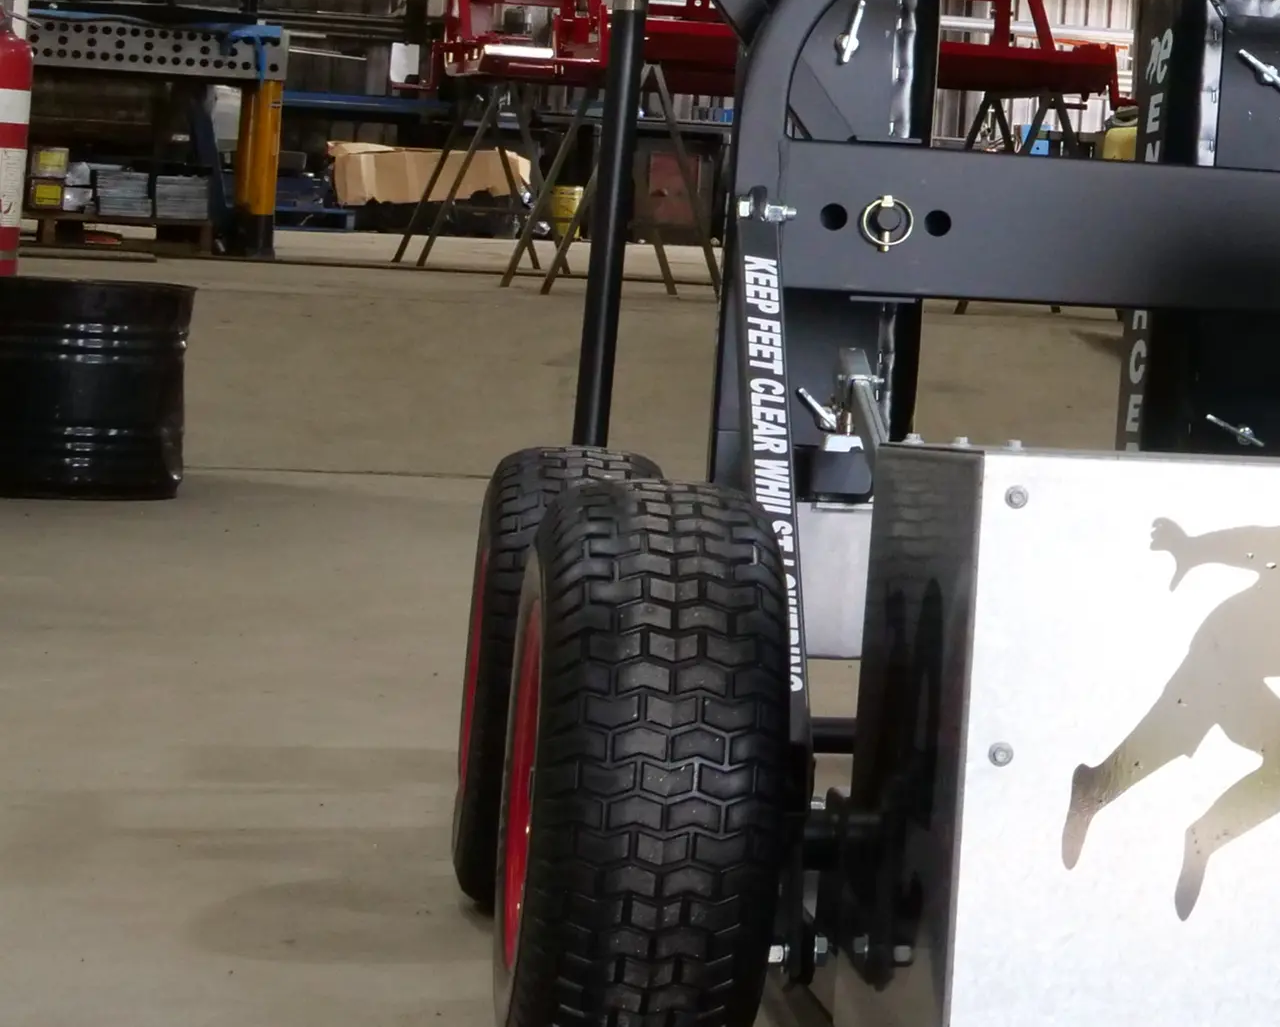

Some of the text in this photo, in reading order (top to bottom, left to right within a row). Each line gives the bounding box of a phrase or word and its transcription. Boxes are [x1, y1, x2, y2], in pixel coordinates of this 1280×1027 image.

[743, 254, 780, 315] KEEP
[746, 316, 783, 376] FEET
[748, 377, 787, 455] CLEAR
